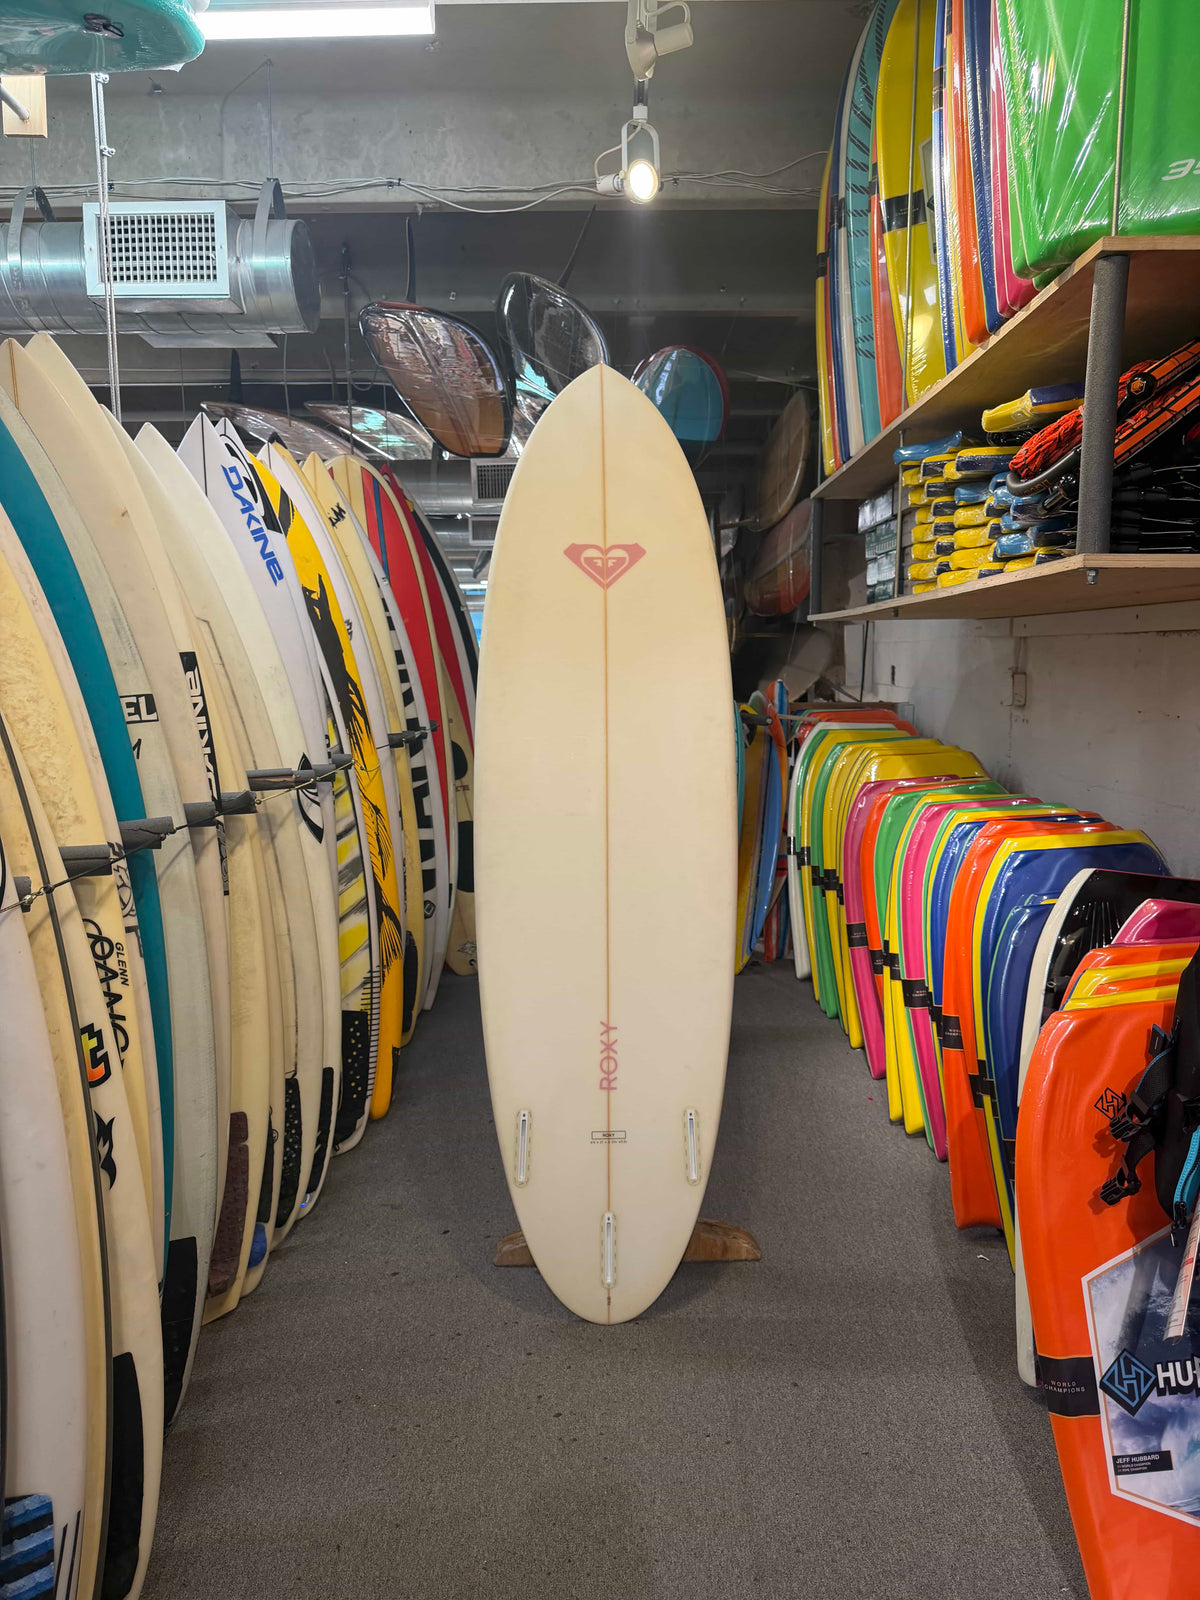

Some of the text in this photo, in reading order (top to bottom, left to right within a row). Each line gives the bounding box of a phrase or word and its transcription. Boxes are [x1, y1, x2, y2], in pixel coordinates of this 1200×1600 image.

[221, 464, 284, 587] DAKINE
[121, 695, 158, 721] EL
[115, 942, 129, 986] GLENN
[600, 1020, 618, 1090] ROXY
[1044, 1384, 1086, 1393] CHAMPIONS
[1051, 1380, 1077, 1388] WORLD
